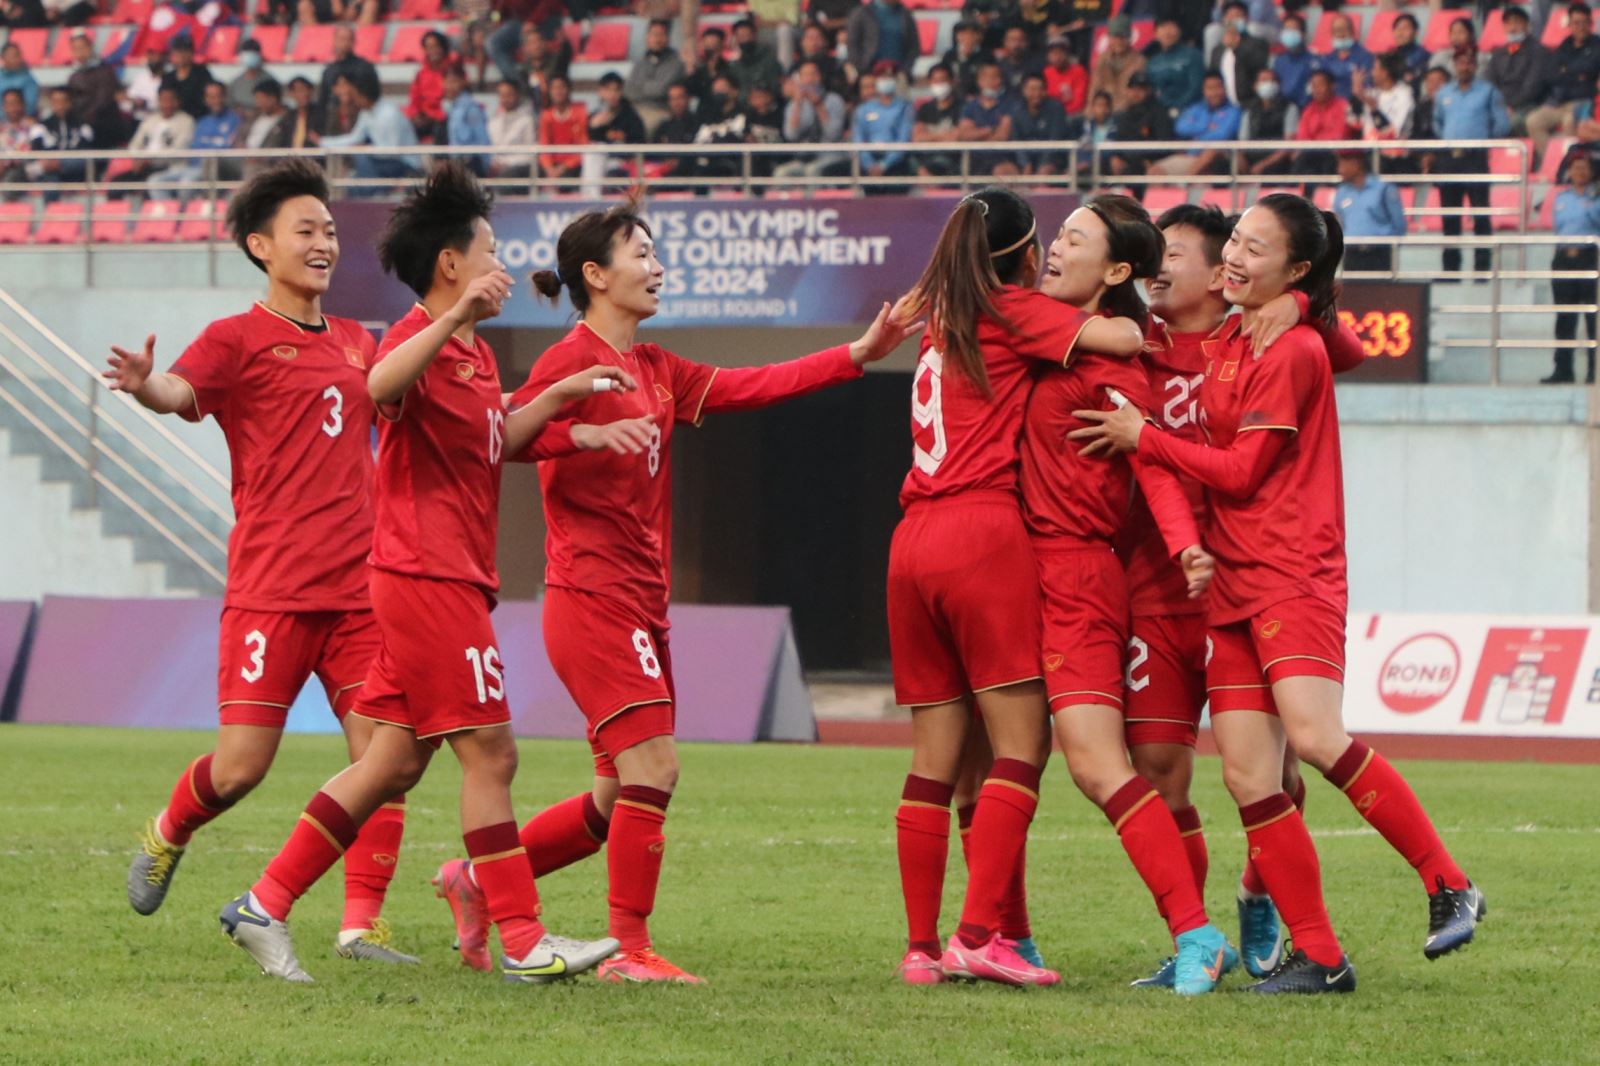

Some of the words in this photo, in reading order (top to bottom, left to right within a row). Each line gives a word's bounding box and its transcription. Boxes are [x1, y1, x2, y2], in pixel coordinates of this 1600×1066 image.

[693, 209, 839, 239] OLYMPIC
[665, 237, 891, 266] TOURNAMENT
[693, 267, 769, 295] 2024
[724, 298, 786, 318] ROUND
[321, 385, 344, 438] 3
[911, 345, 948, 477] 9
[647, 422, 661, 478] 8
[240, 629, 267, 683] 3
[631, 628, 662, 680] 8
[1386, 665, 1453, 683] RONB
